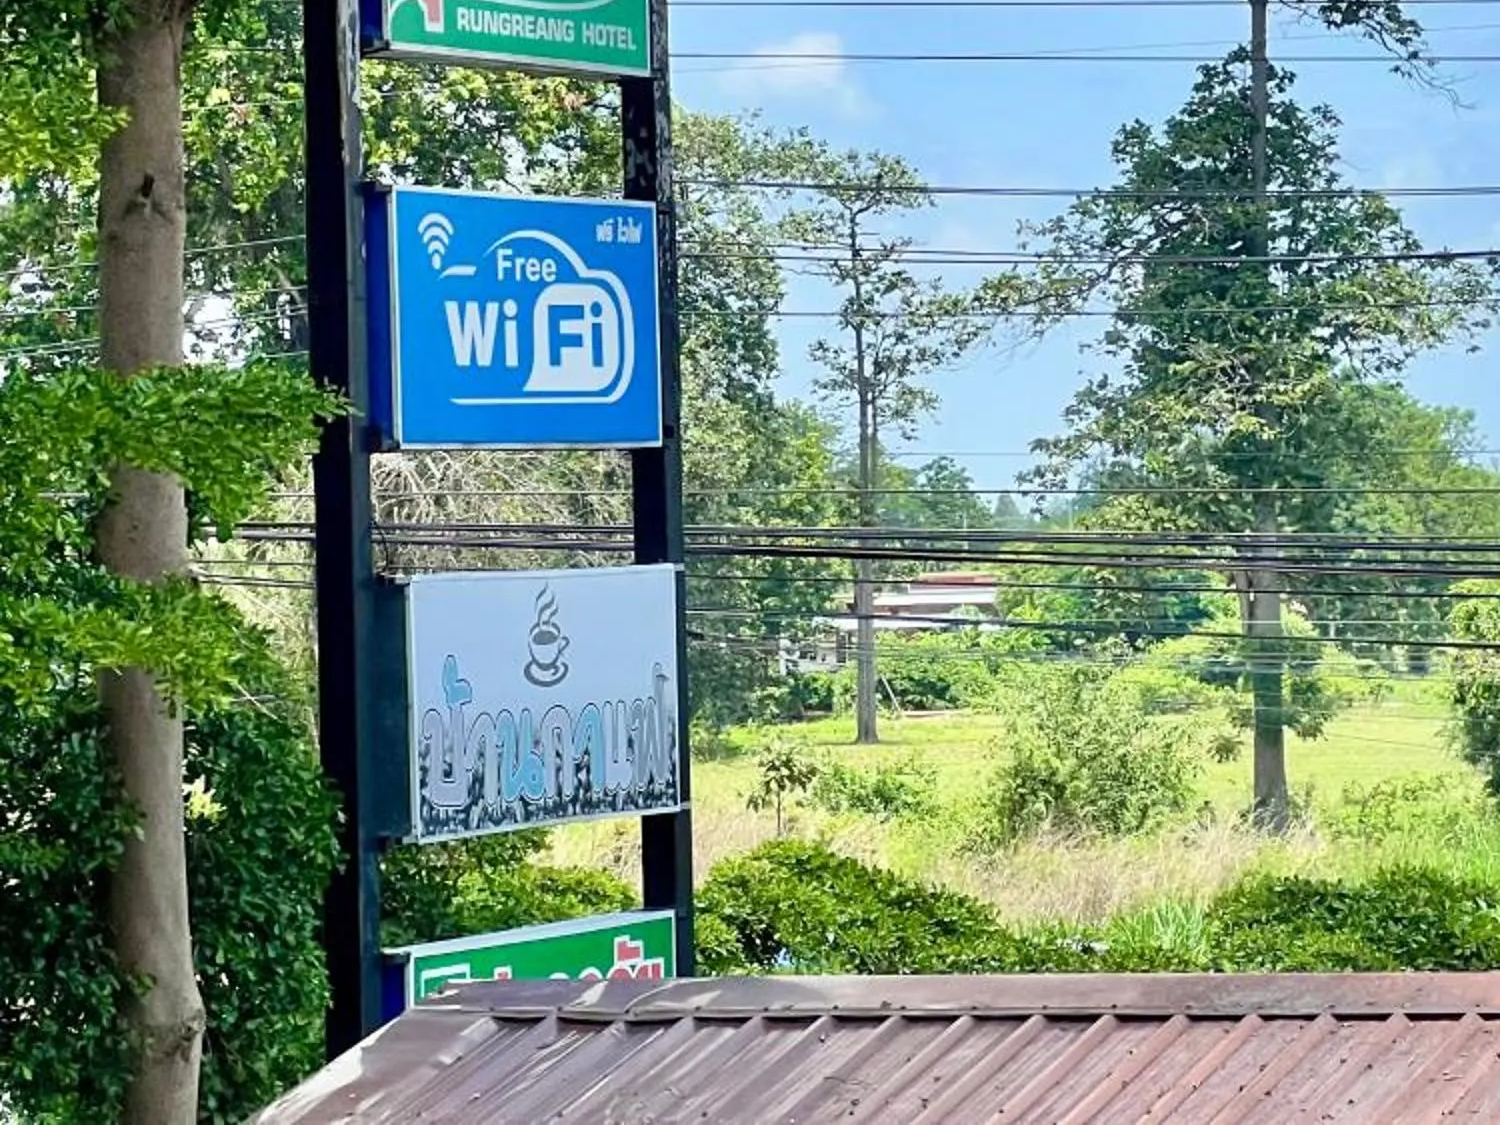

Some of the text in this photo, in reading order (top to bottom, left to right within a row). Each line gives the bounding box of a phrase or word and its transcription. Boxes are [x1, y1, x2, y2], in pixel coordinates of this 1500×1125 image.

[456, 6, 637, 50] RUNGREANG HOTEL
[496, 248, 558, 282] Free
